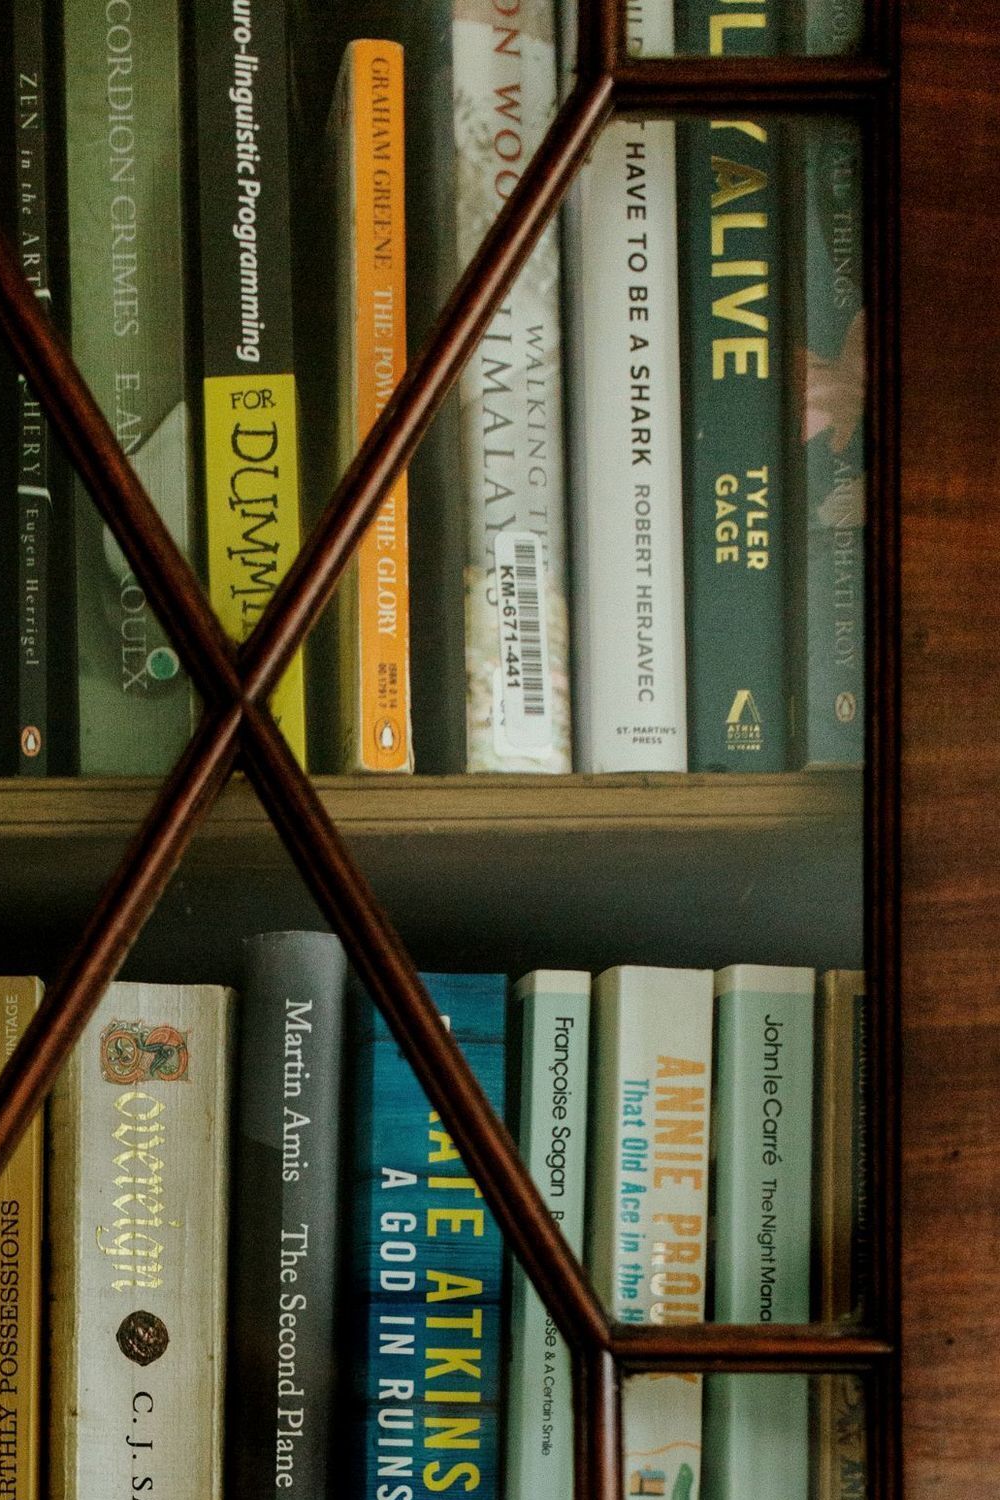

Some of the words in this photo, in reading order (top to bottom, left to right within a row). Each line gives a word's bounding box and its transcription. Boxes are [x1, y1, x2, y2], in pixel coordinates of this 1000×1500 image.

[371, 57, 391, 162] GRAHAM
[372, 169, 392, 271] GREENE
[626, 143, 647, 221] HAVE
[237, 179, 265, 362] Programming
[628, 233, 647, 272] TO
[711, 155, 769, 380] ALIVE
[629, 286, 648, 321] BE
[630, 335, 649, 352] A
[231, 390, 276, 409] FOR
[526, 324, 548, 488] WALKING
[630, 366, 652, 465] SHARK
[634, 484, 652, 578] ROBERT
[715, 475, 740, 564] GAGE
[746, 466, 769, 571] TYLER
[377, 558, 398, 640] GLORY
[500, 565, 521, 688] KM-671-441
[637, 584, 654, 703] HERJAVEC
[284, 999, 312, 1098] Martin
[551, 1017, 574, 1119] Françoise
[764, 1014, 783, 1068] John
[653, 1055, 705, 1189] ANNIE
[763, 1072, 778, 1096] le
[283, 1106, 311, 1182] Amis
[546, 1123, 571, 1197] Sagan
[762, 1098, 783, 1167] Carré
[381, 1167, 417, 1190] A
[280, 1223, 309, 1283] The
[379, 1211, 417, 1292] GOD
[0, 1200, 20, 1394] POSSESSIONS
[379, 1316, 415, 1355] IN
[277, 1293, 306, 1396] Second
[126, 1435, 154, 1459] J.
[132, 1391, 154, 1424] C.
[276, 1407, 305, 1488] Plane
